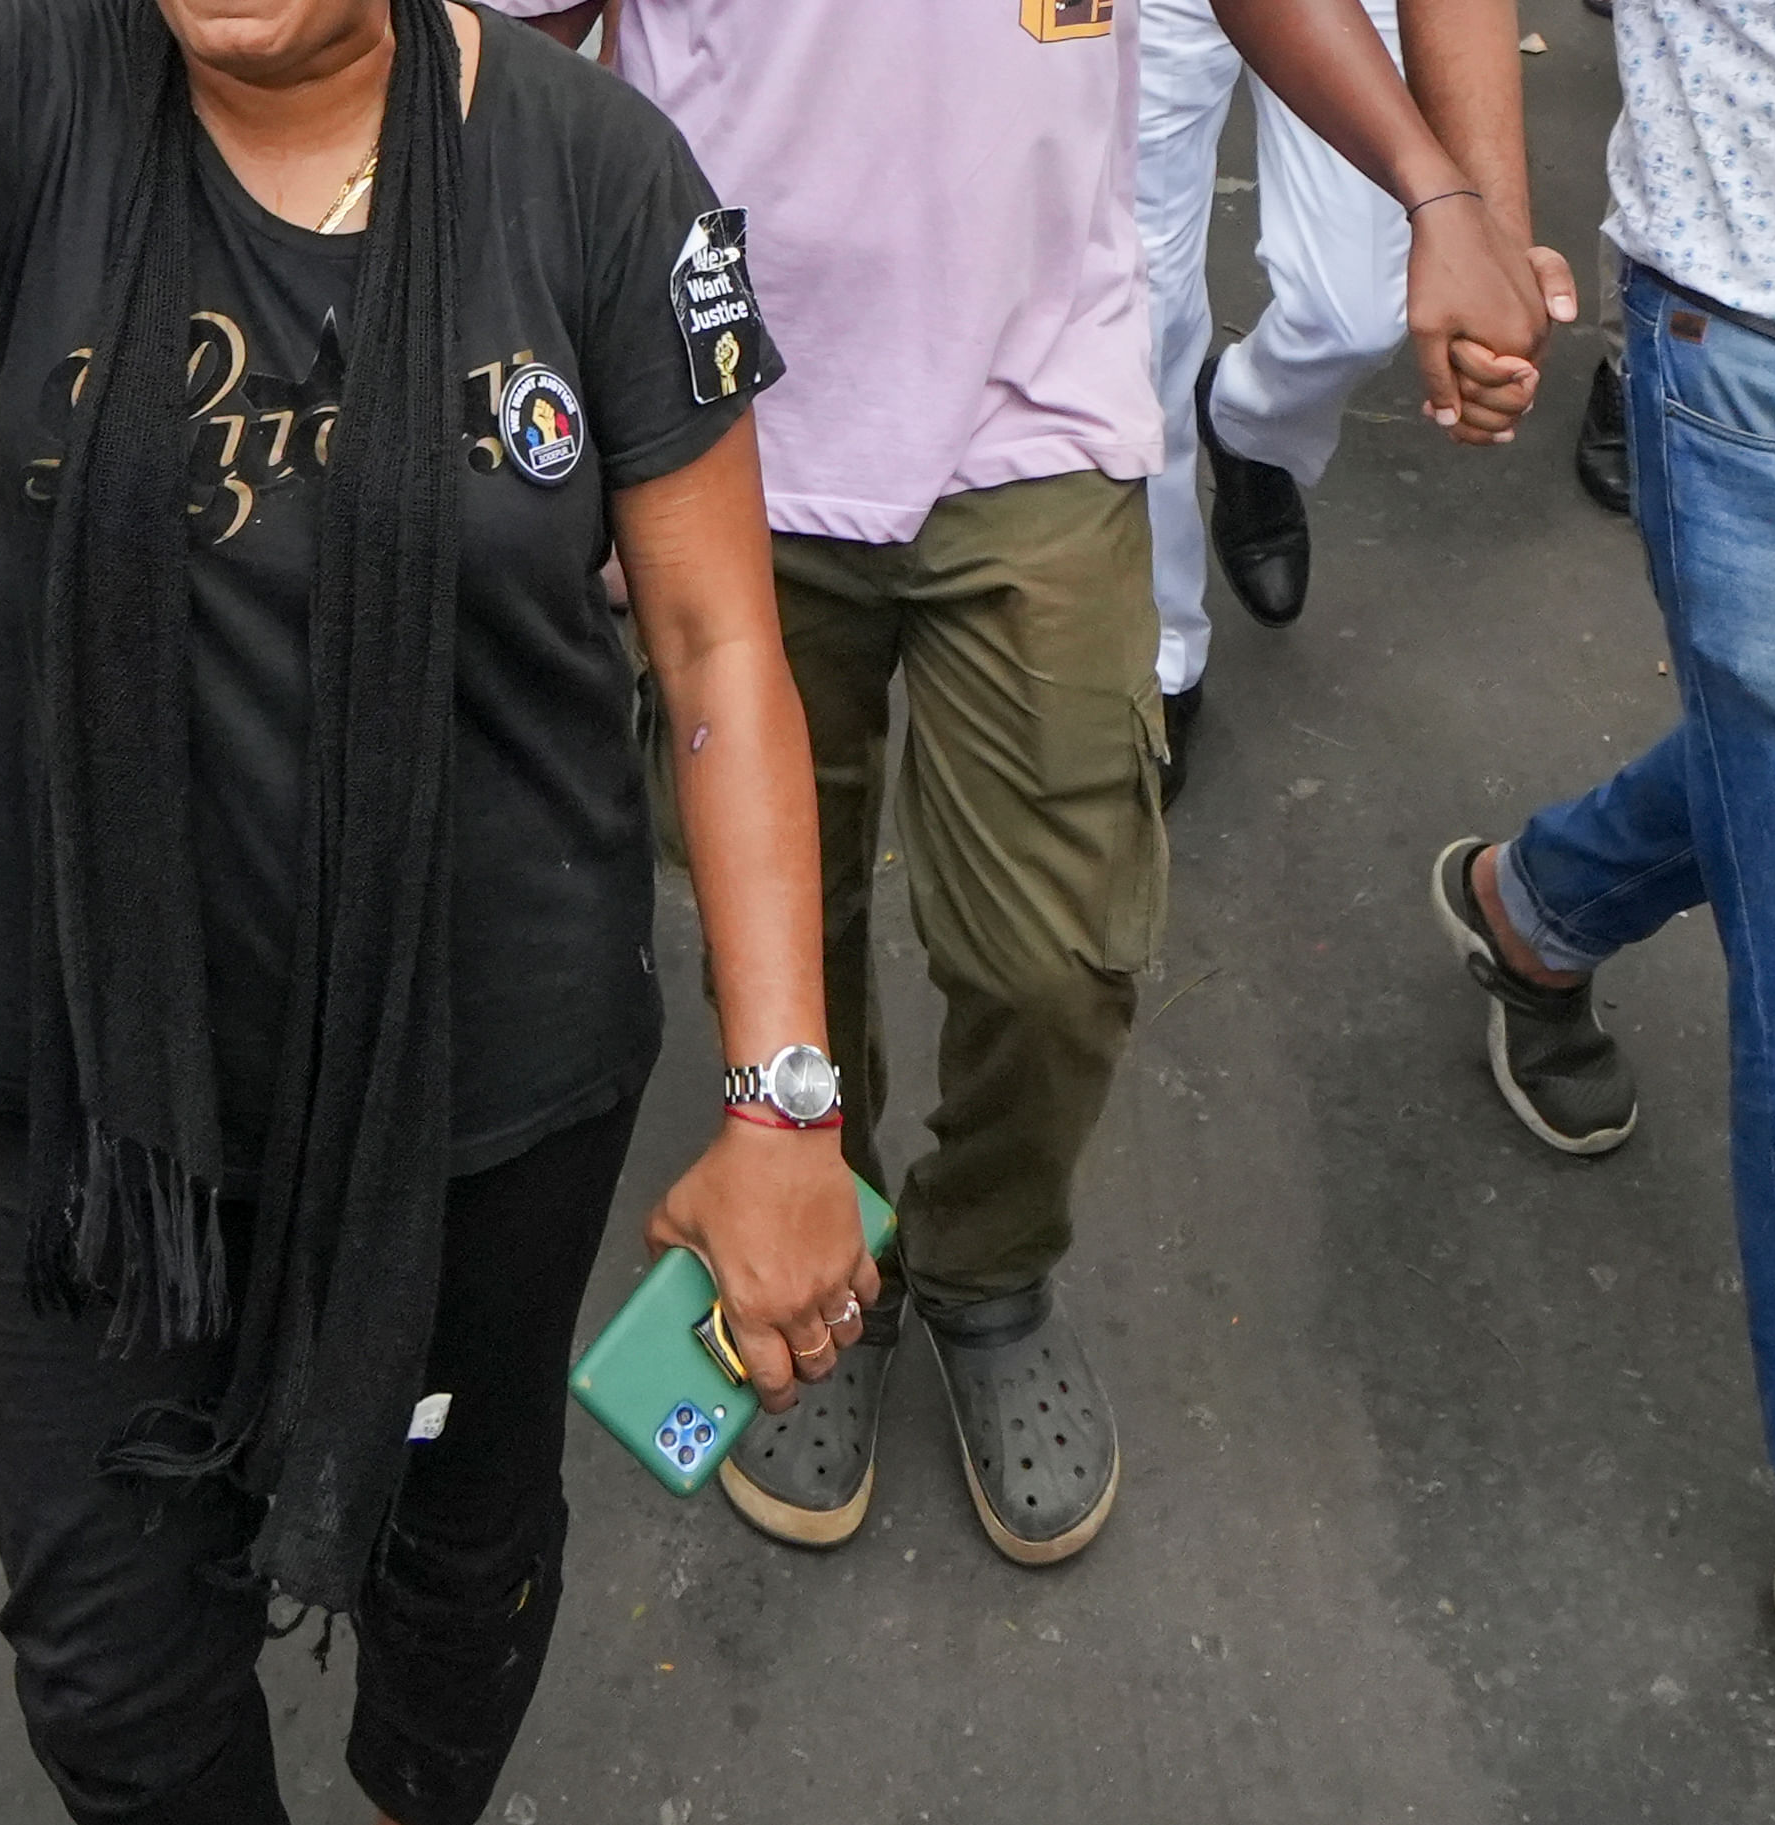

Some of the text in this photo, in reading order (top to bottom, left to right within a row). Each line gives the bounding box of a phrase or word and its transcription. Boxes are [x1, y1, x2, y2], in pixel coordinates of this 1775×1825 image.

[692, 248, 719, 271] We
[687, 273, 733, 303] Want
[690, 298, 749, 334] Justice
[509, 375, 577, 435] WE WANT JUSTICE
